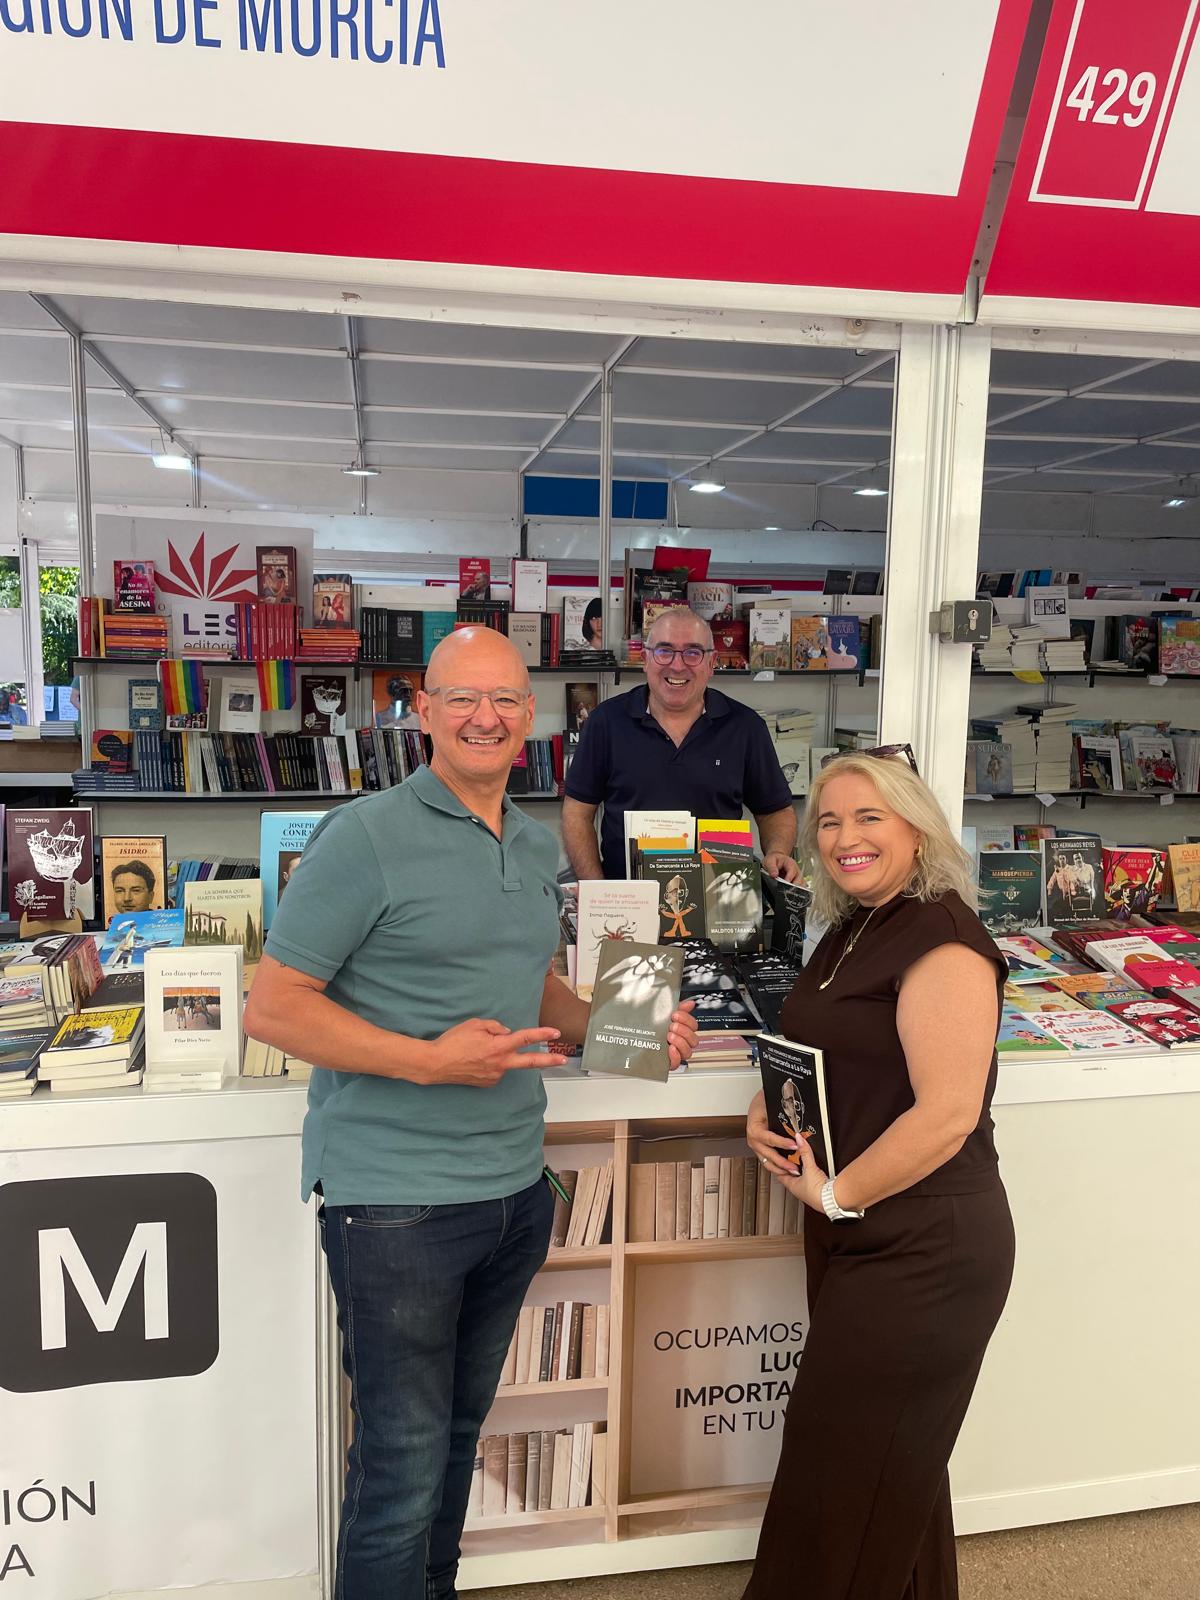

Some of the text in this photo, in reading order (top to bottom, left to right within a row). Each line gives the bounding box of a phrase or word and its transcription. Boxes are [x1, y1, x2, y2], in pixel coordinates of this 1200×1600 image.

[155, 0, 222, 48] DE
[239, 0, 446, 69] MURCIA
[1066, 66, 1156, 128] 429
[596, 1034, 661, 1051] MALDITOS TÁBANOS
[1053, 1024, 1126, 1035] ALHAMBRA
[769, 1054, 790, 1069] Samarcanda
[800, 1065, 812, 1076] Raya
[38, 1221, 170, 1350] M
[654, 1322, 803, 1351] OCUPAMOS
[675, 1380, 791, 1409] IMPORTA
[704, 1414, 736, 1435] EN
[742, 1410, 775, 1432] TU
[3, 1479, 96, 1526] IÓN
[0, 1544, 36, 1581] A
